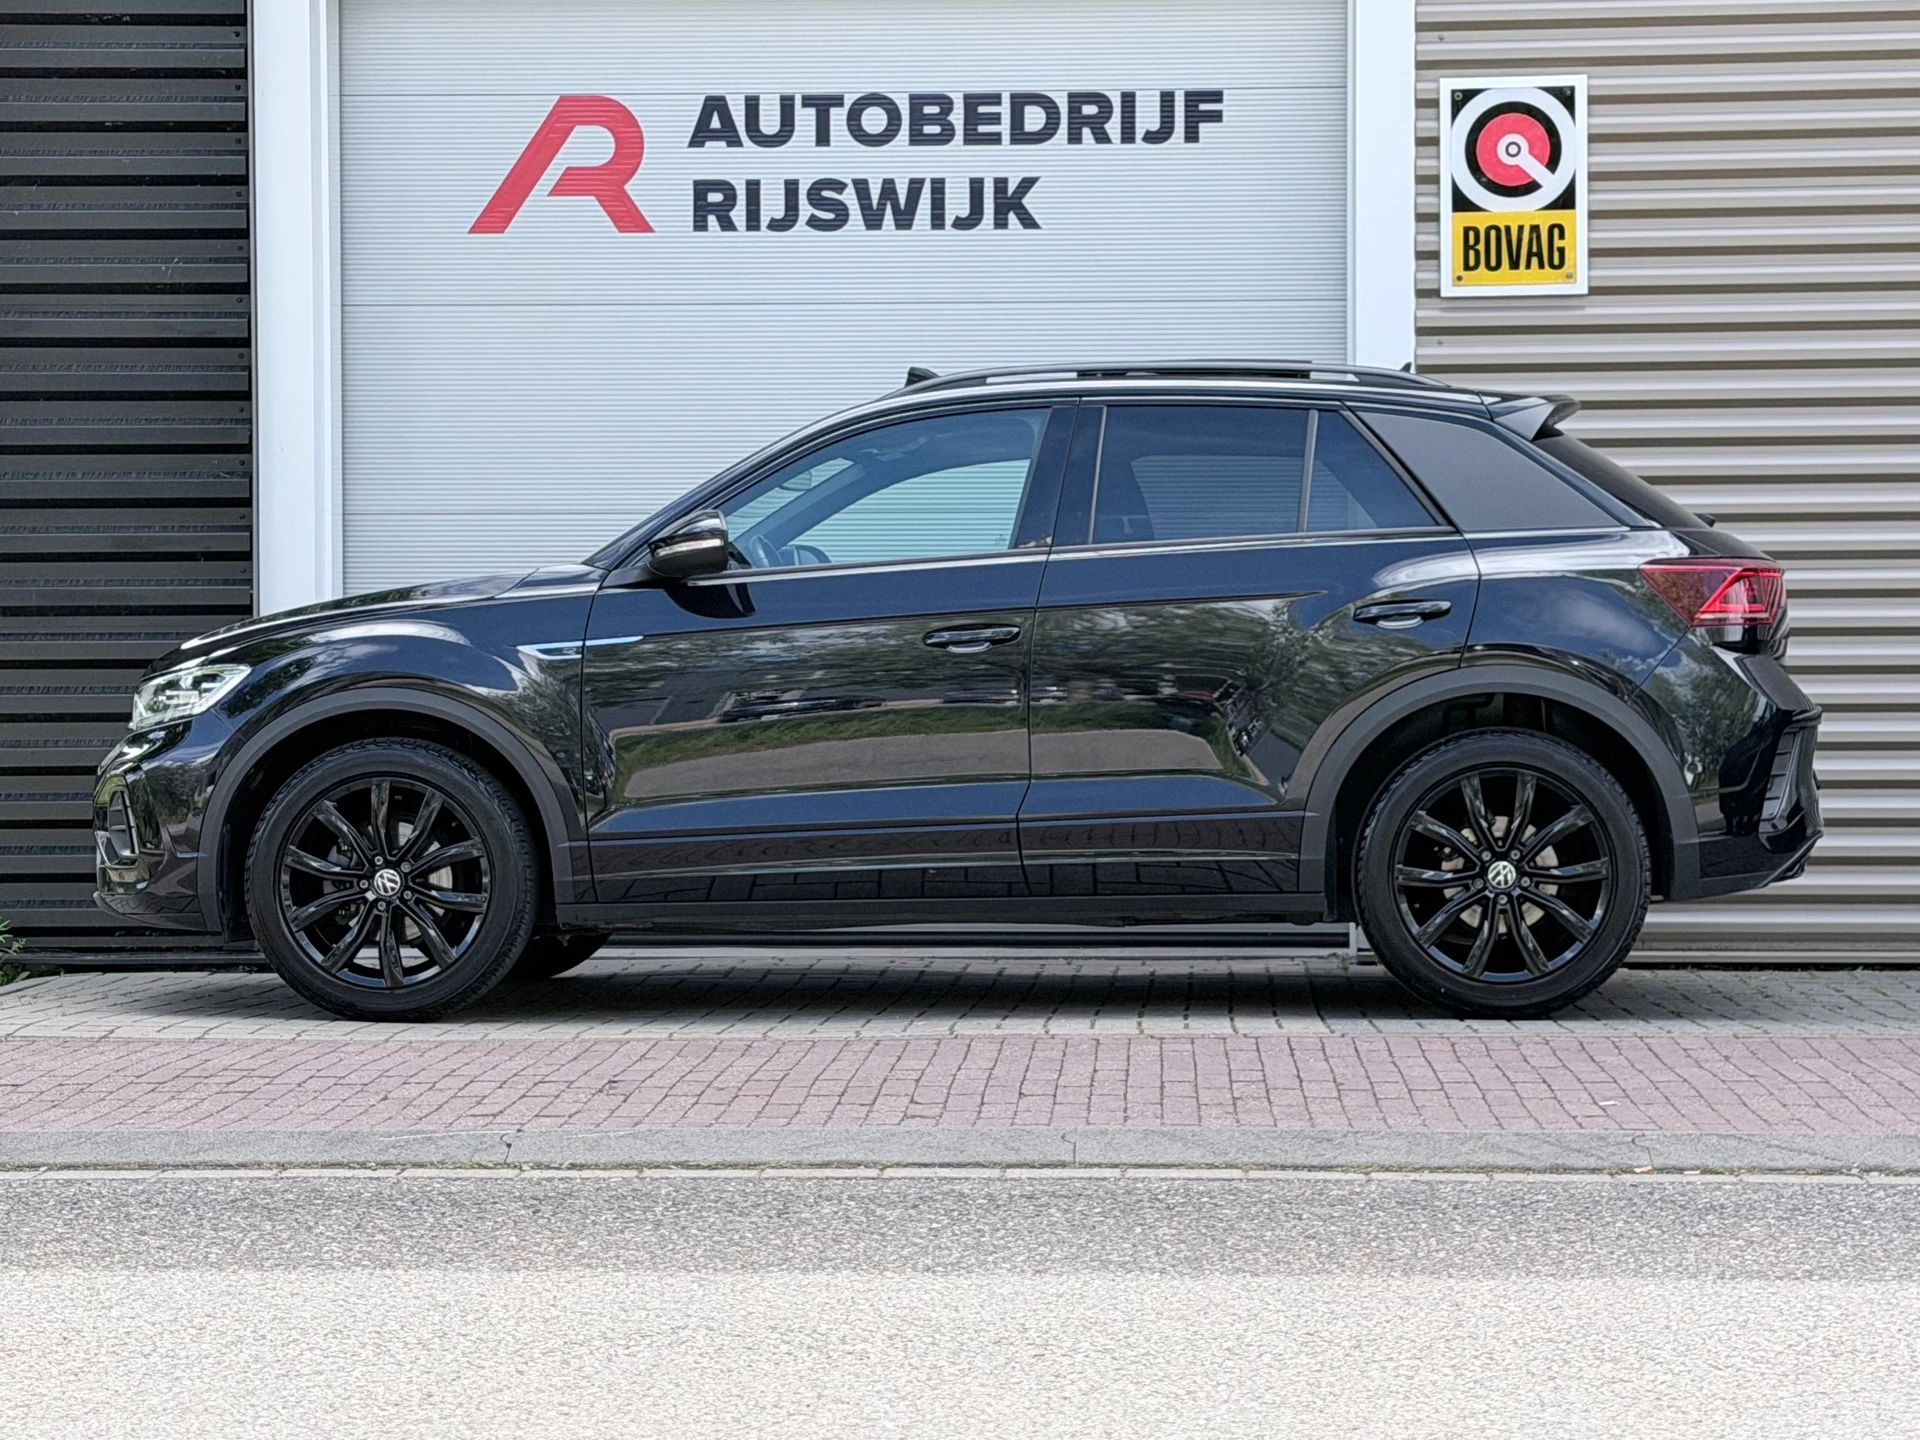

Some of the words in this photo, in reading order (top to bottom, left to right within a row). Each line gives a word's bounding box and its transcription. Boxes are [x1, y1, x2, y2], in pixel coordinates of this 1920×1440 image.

[688, 90, 1224, 148] AUTOBEDRIJF
[692, 176, 1042, 232] RIJSWIJK
[1463, 223, 1566, 272] BOVAG
